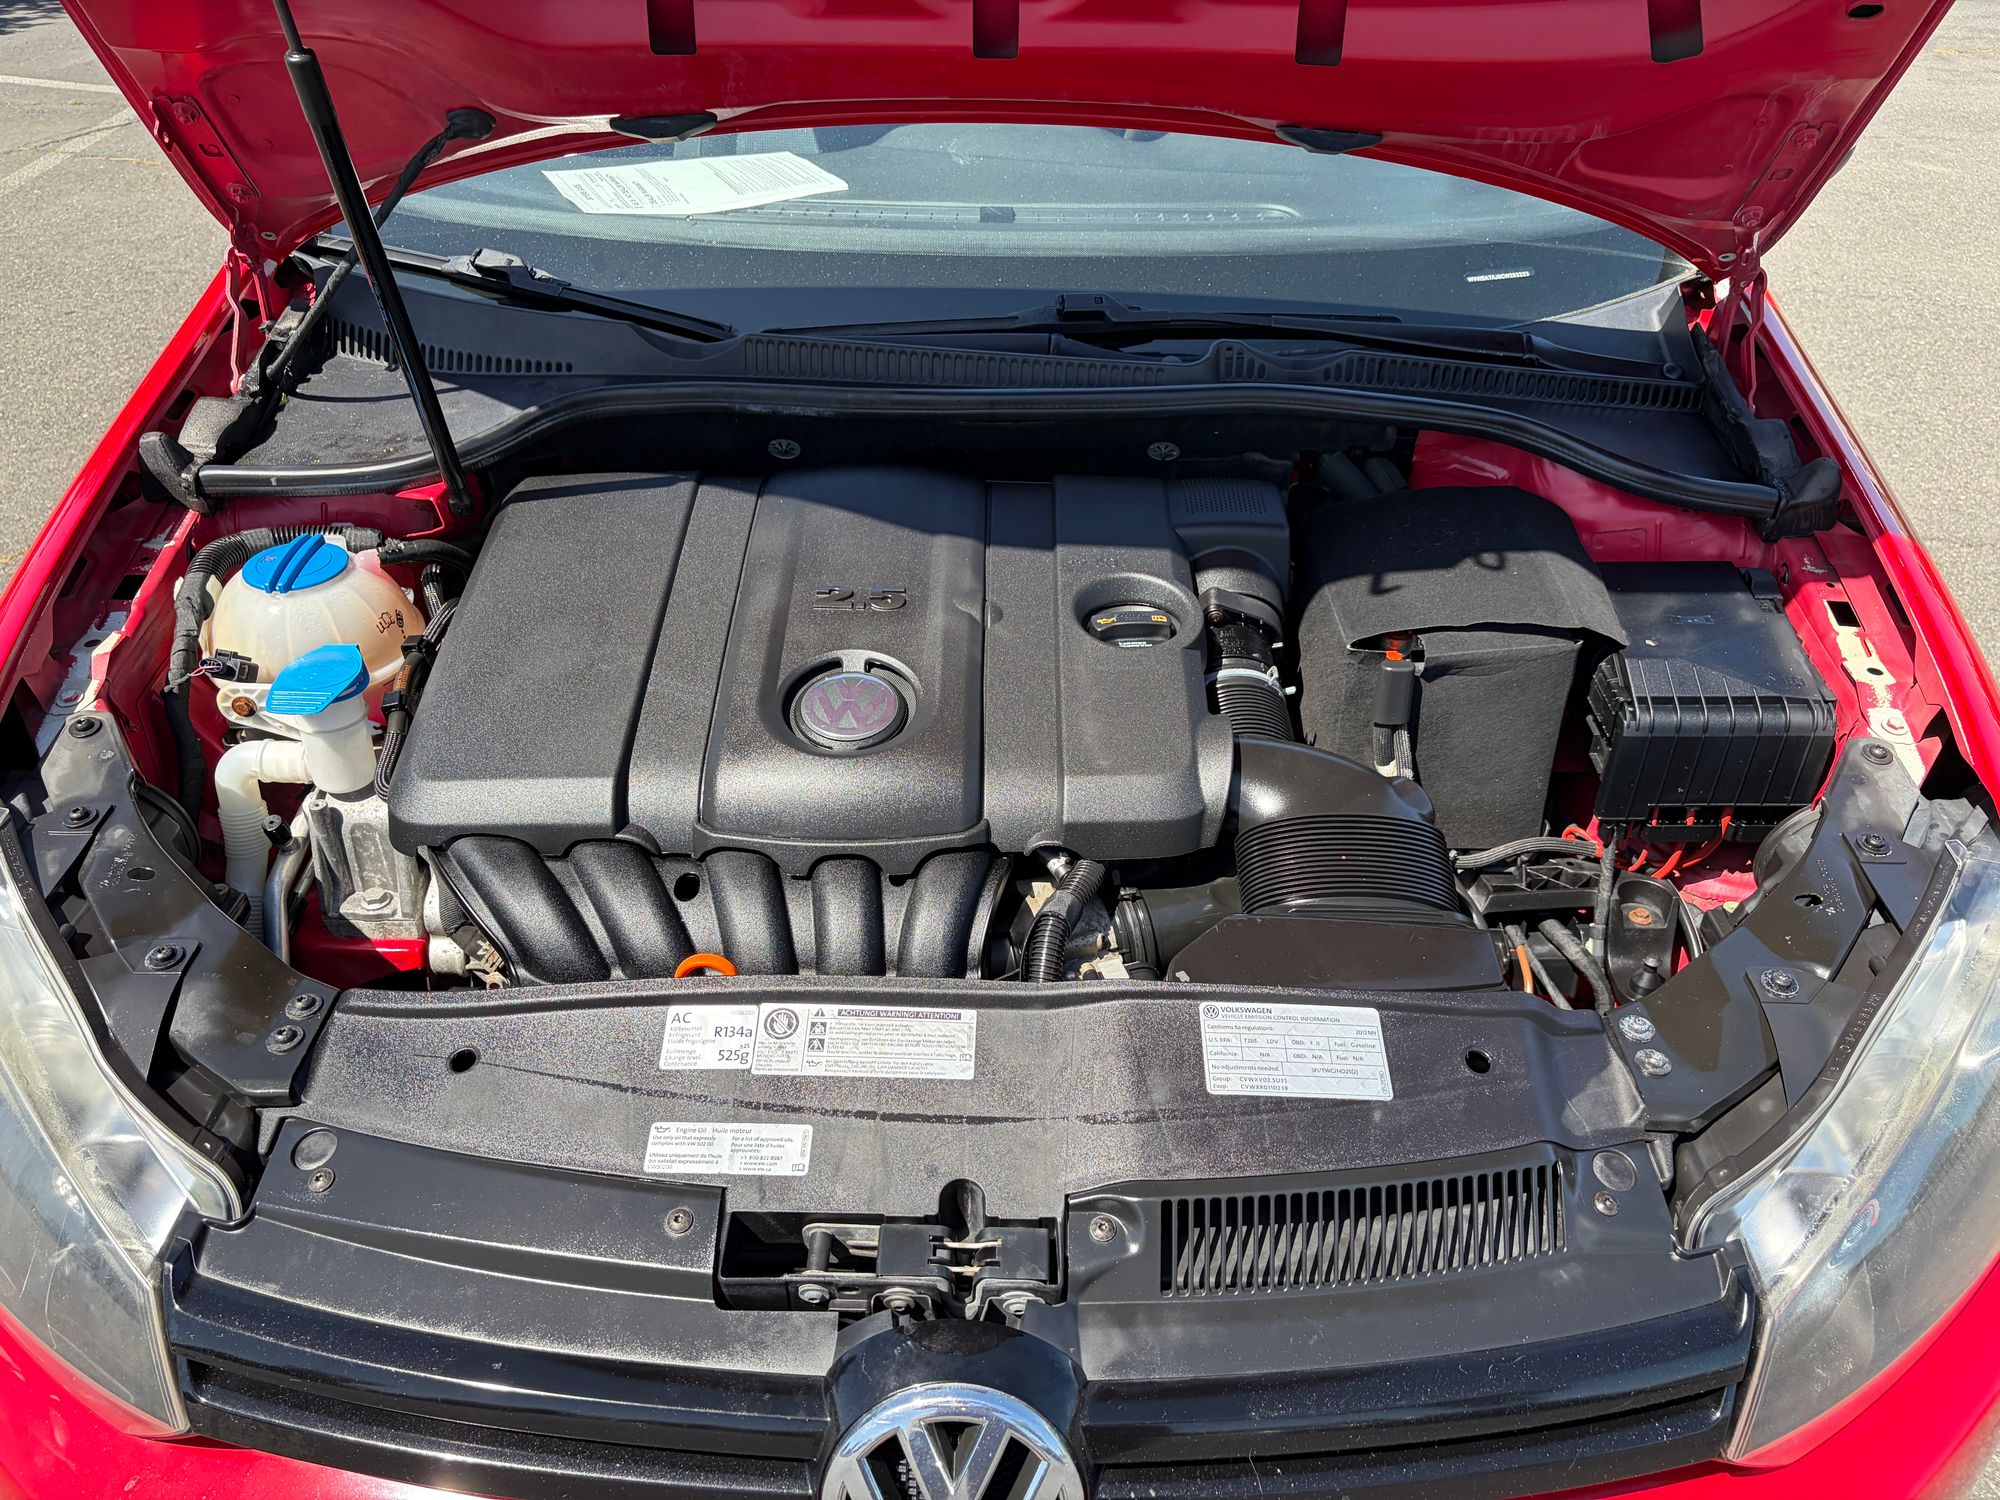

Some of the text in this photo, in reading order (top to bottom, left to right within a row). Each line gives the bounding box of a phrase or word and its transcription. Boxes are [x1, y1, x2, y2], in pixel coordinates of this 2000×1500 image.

[813, 587, 907, 611] 2.5
[801, 673, 898, 740] VW
[671, 1012, 692, 1024] AC
[918, 1012, 959, 1020] ATTENTION!
[714, 1026, 753, 1038] R134a
[718, 1050, 750, 1064] 525g
